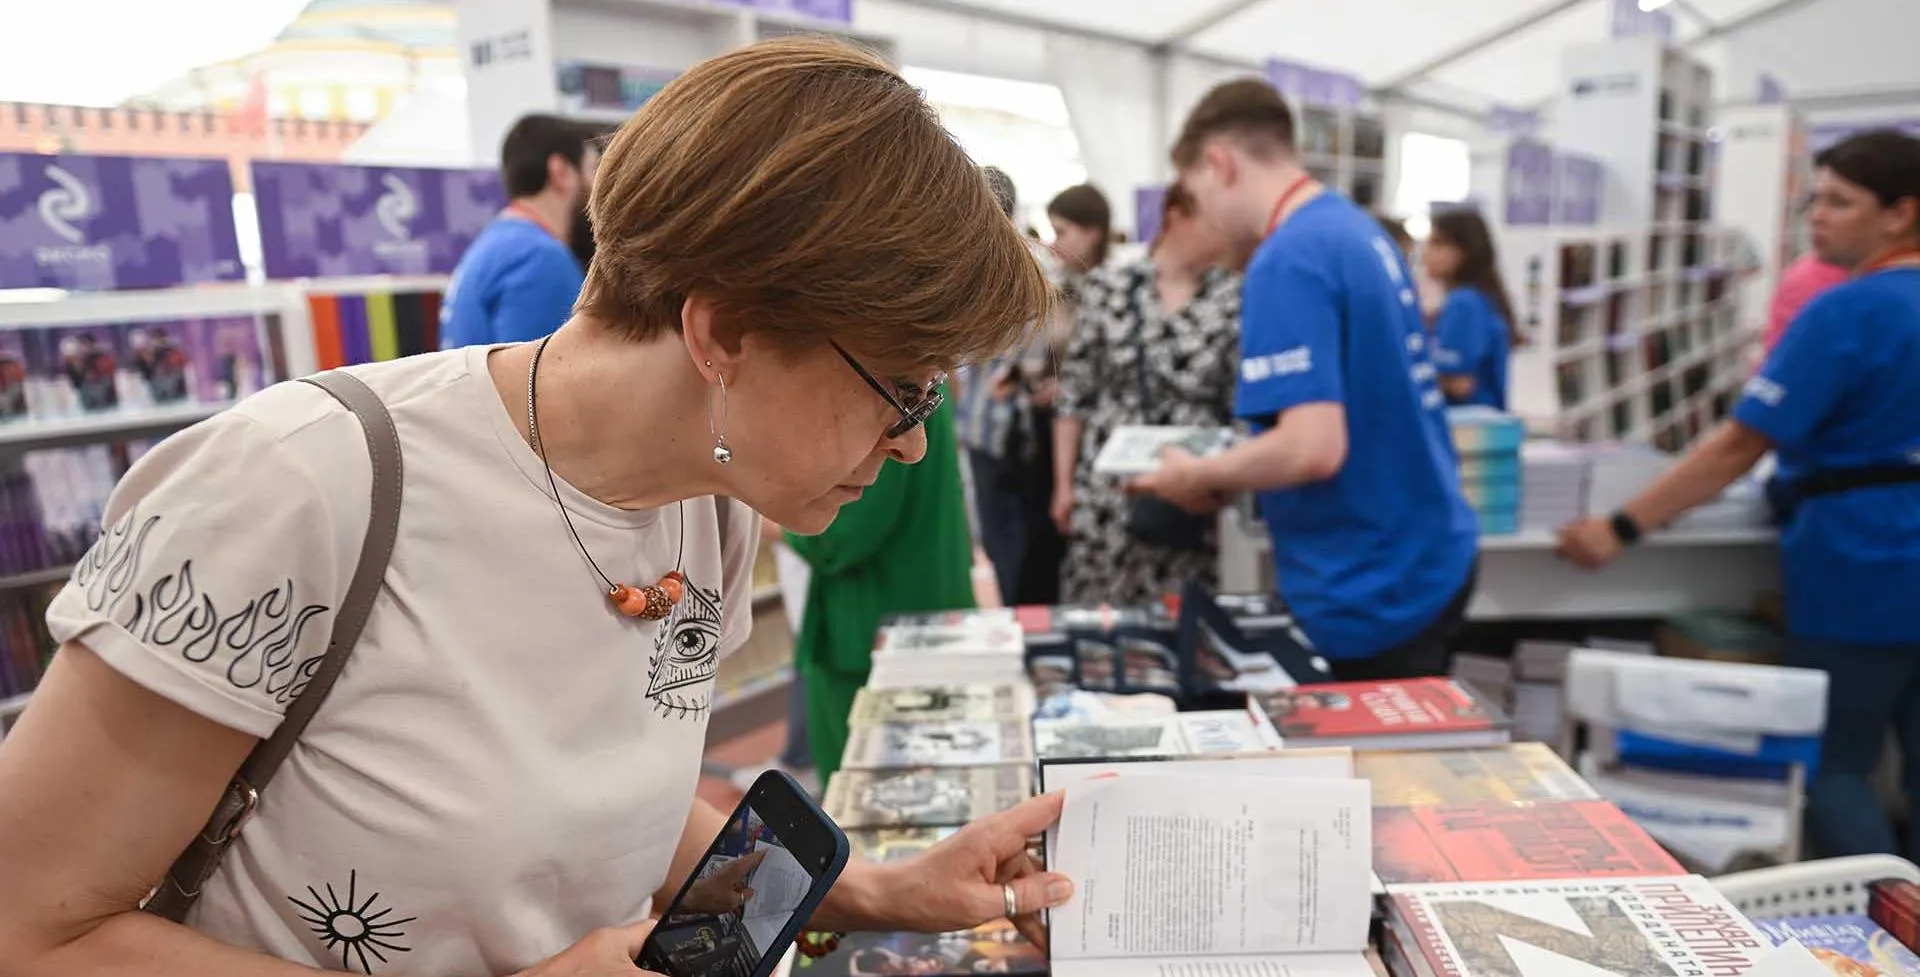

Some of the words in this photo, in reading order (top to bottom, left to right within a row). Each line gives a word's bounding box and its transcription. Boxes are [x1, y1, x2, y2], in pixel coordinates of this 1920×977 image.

[1602, 883, 1704, 977] КООРДИНАТА
[1634, 882, 1753, 977] ПРИЛЕПИН
[1697, 903, 1760, 949] ЗАХАР
